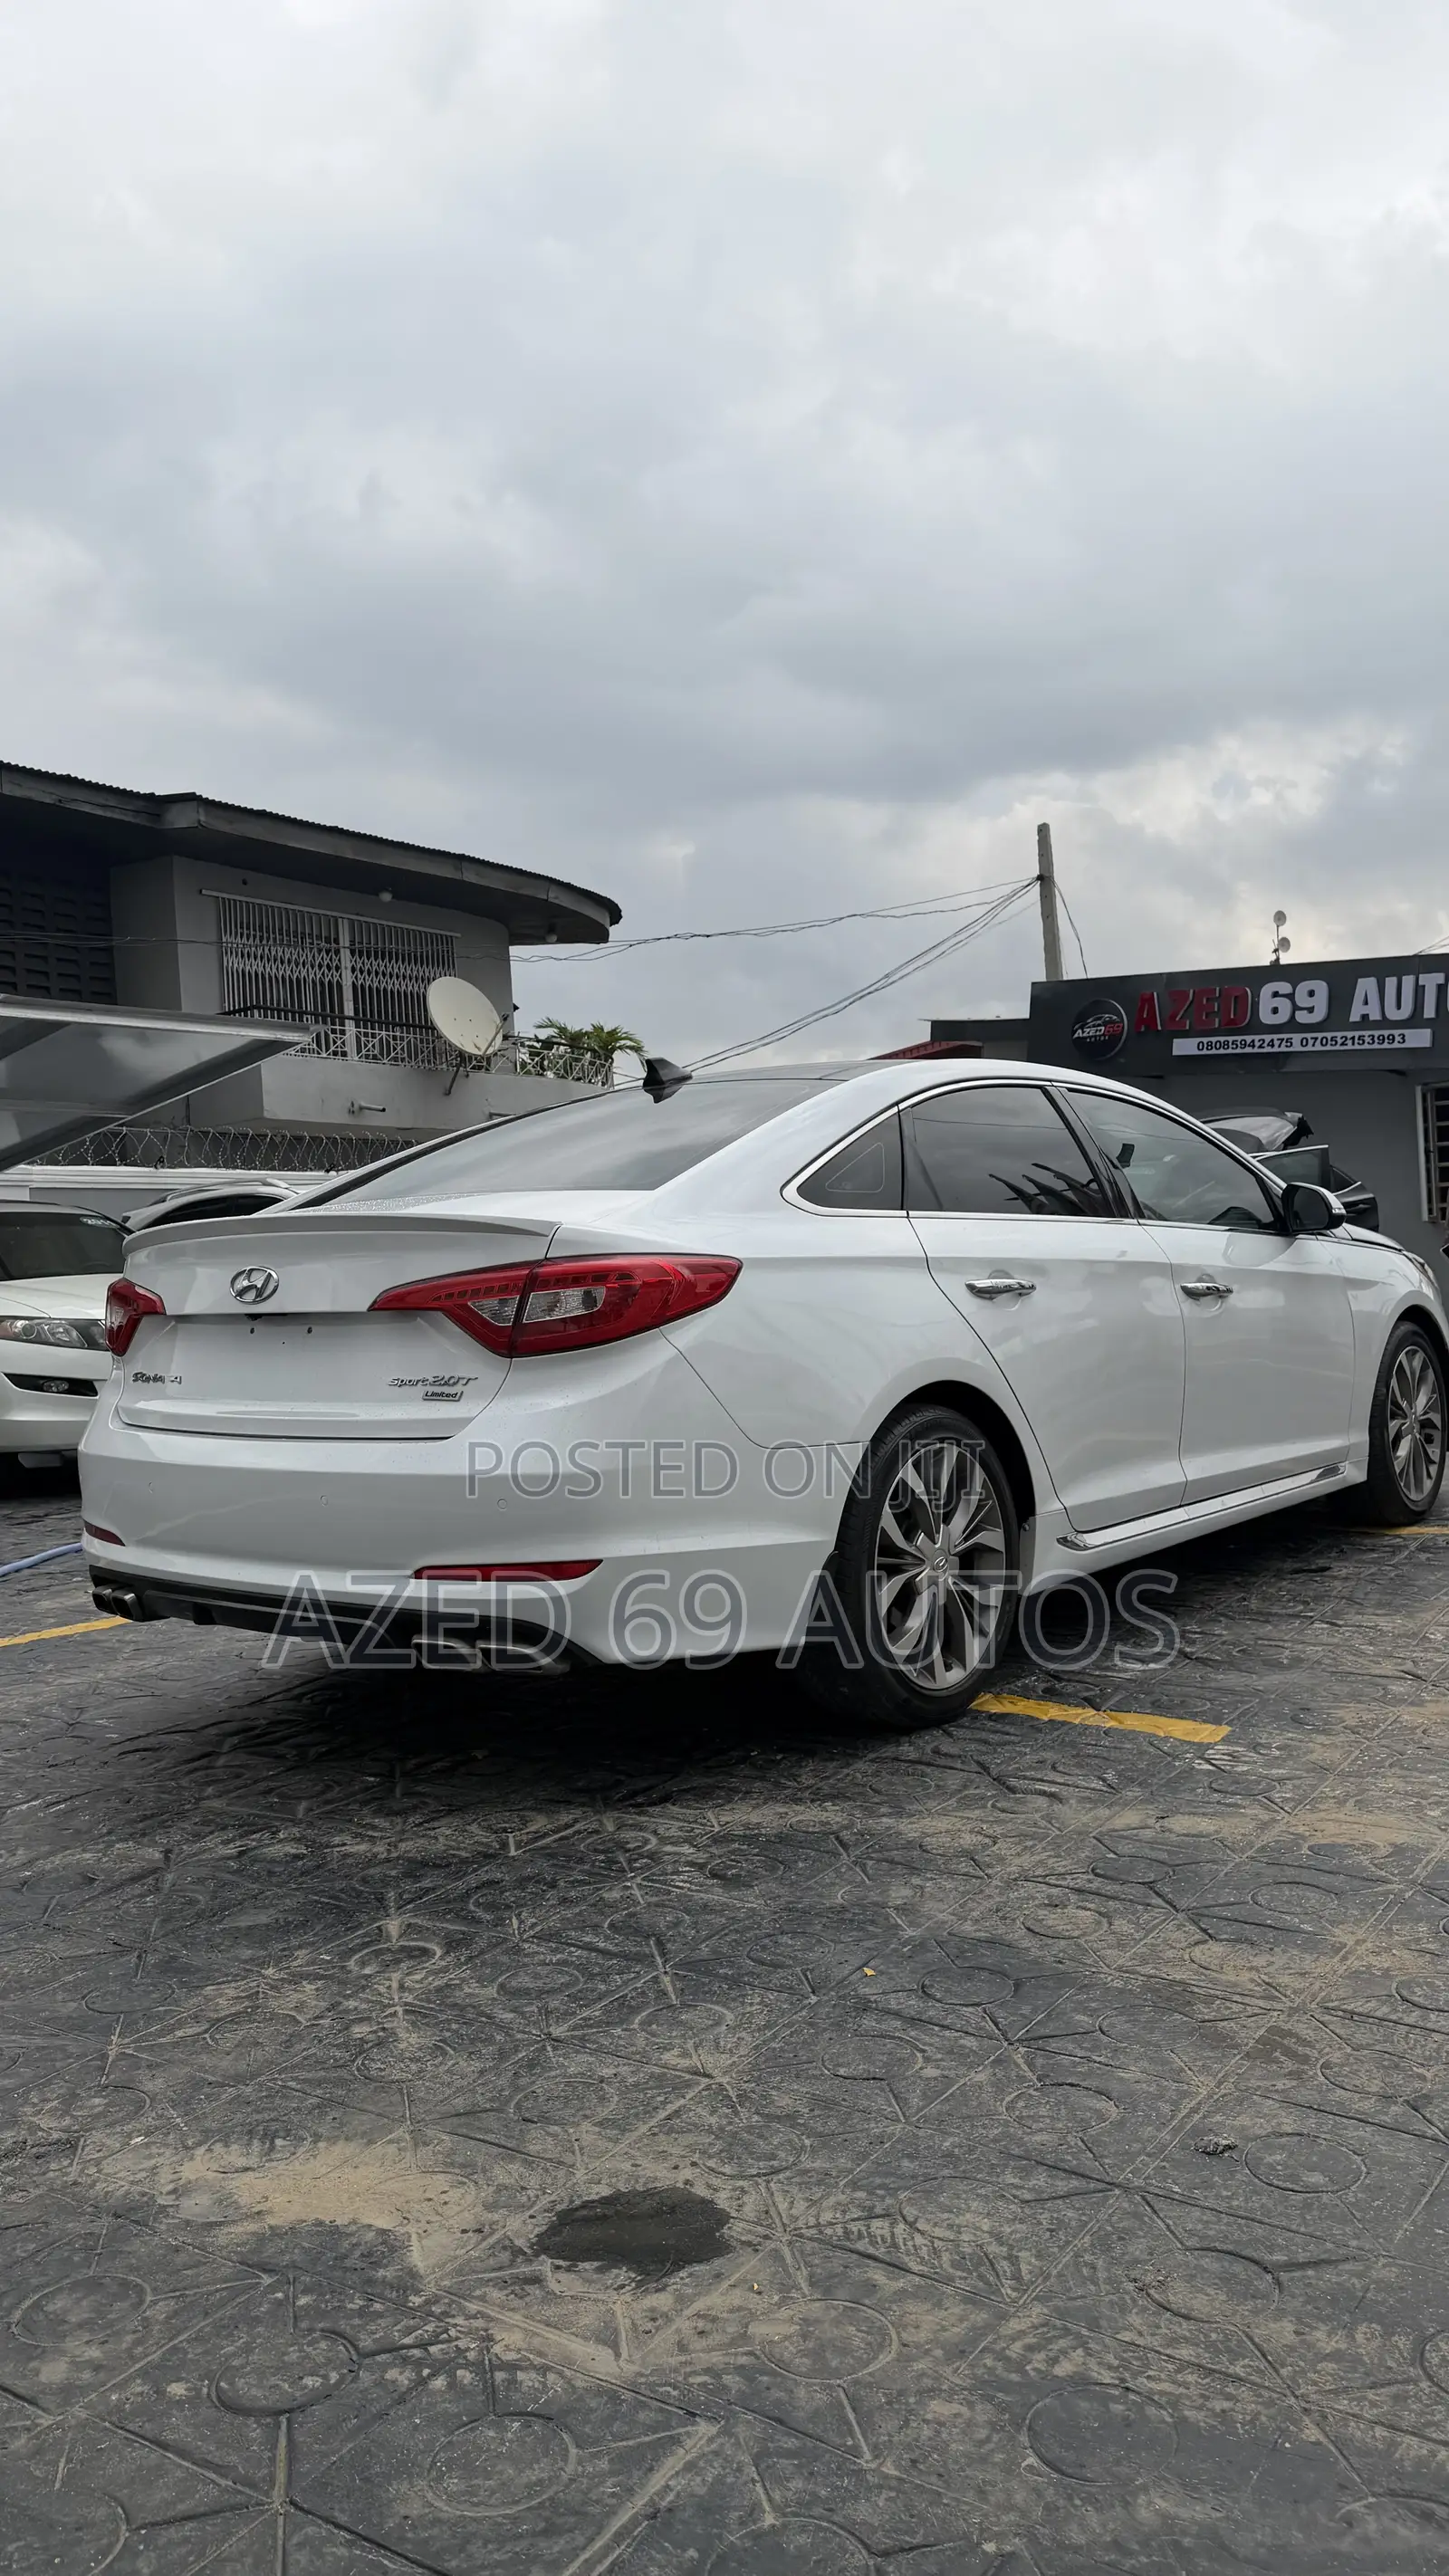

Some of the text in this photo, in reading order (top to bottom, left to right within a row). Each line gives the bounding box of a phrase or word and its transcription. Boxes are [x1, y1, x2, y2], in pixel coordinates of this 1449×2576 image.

[1348, 972, 1449, 1022] AUT
[1196, 1033, 1406, 1051] 08085942475 07052153993
[425, 1390, 459, 1399] Limited
